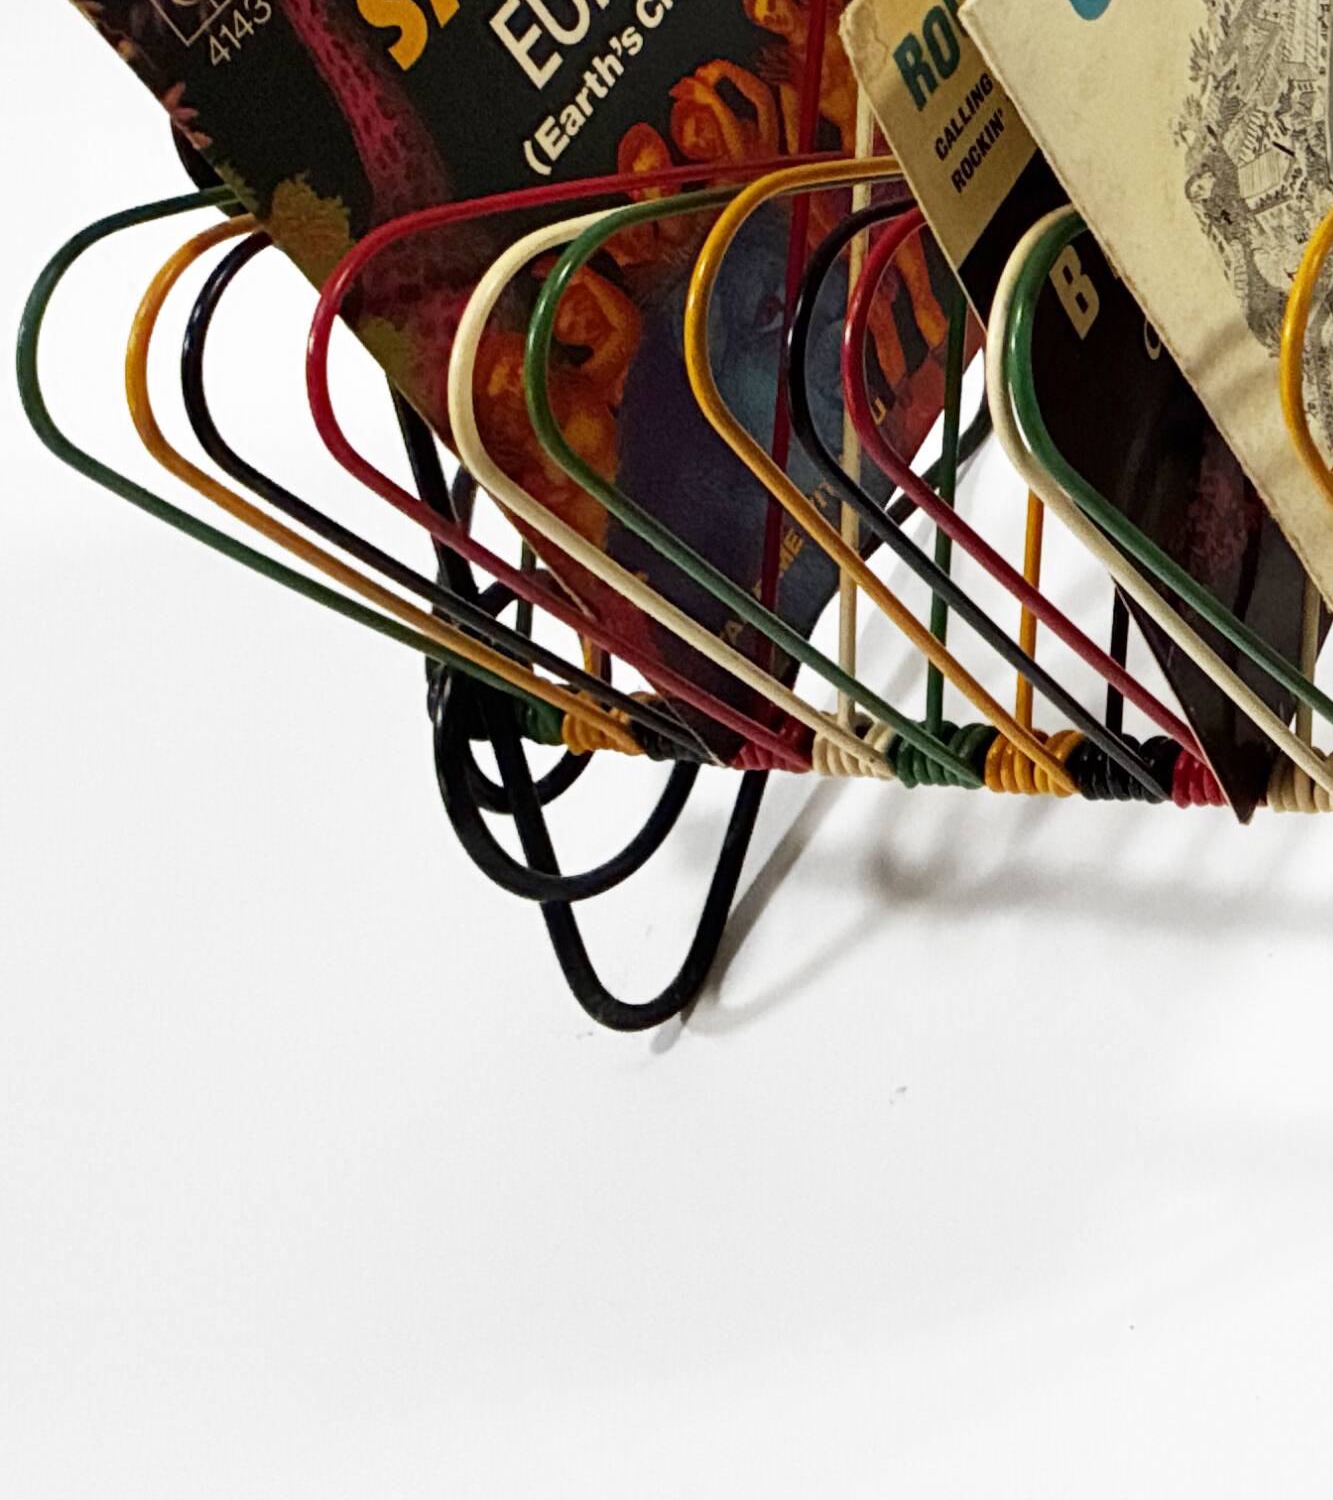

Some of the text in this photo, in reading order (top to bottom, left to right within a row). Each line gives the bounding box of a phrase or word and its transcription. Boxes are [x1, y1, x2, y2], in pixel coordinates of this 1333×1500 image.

[523, 24, 645, 176] (Earth's
[934, 72, 994, 161] CALLING
[951, 108, 1004, 193] ROCKIN'
